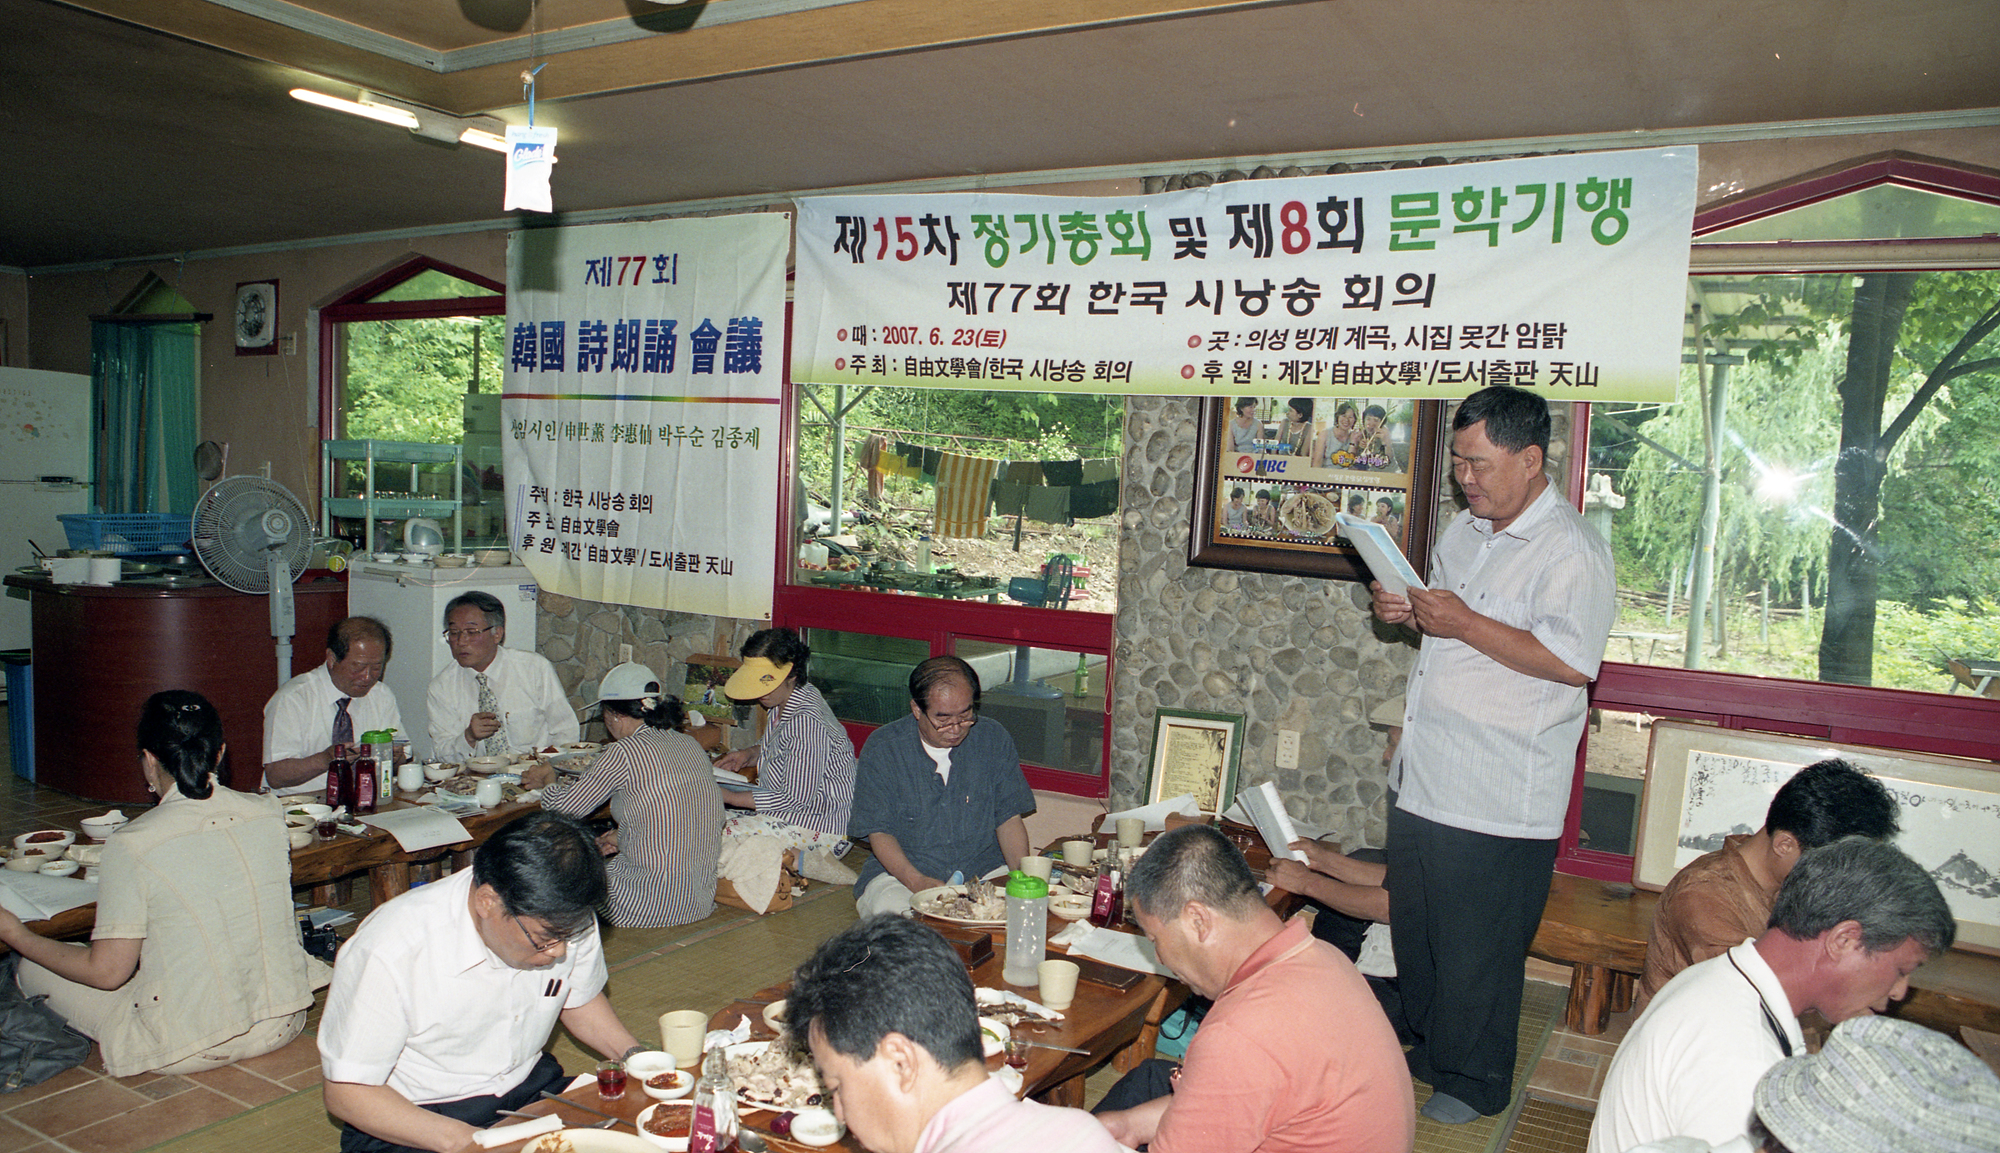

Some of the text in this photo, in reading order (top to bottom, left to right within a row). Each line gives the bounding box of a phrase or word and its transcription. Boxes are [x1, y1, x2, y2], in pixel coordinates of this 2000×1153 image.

[834, 177, 1632, 268] 제15차 정기총회 및 제8회 문학기행
[584, 253, 678, 287] 제77회
[947, 273, 1436, 316] 제77회 한국 시낭송 회의
[511, 316, 763, 375] 韓國 詩朗誦 會議
[883, 326, 923, 345] 2007.
[929, 327, 944, 346] 6.
[951, 328, 1007, 349] 23(토)
[1245, 328, 1289, 350] 의성
[1295, 327, 1339, 350] 빙계
[1344, 325, 1397, 351] 계곡,
[1404, 325, 1452, 350] 시집
[1459, 323, 1509, 349] 못간
[1516, 322, 1567, 349] 암탉
[1030, 358, 1086, 382] 시낭송
[1093, 359, 1133, 383] 회의
[1549, 361, 1599, 387] 天山
[658, 423, 703, 448] 박두순
[710, 425, 760, 450] 김종제
[562, 488, 583, 509] 한국
[588, 491, 626, 512] 시낭송
[629, 493, 653, 514] 회의
[561, 515, 620, 538] 自由文學會
[705, 555, 733, 577] 天山
